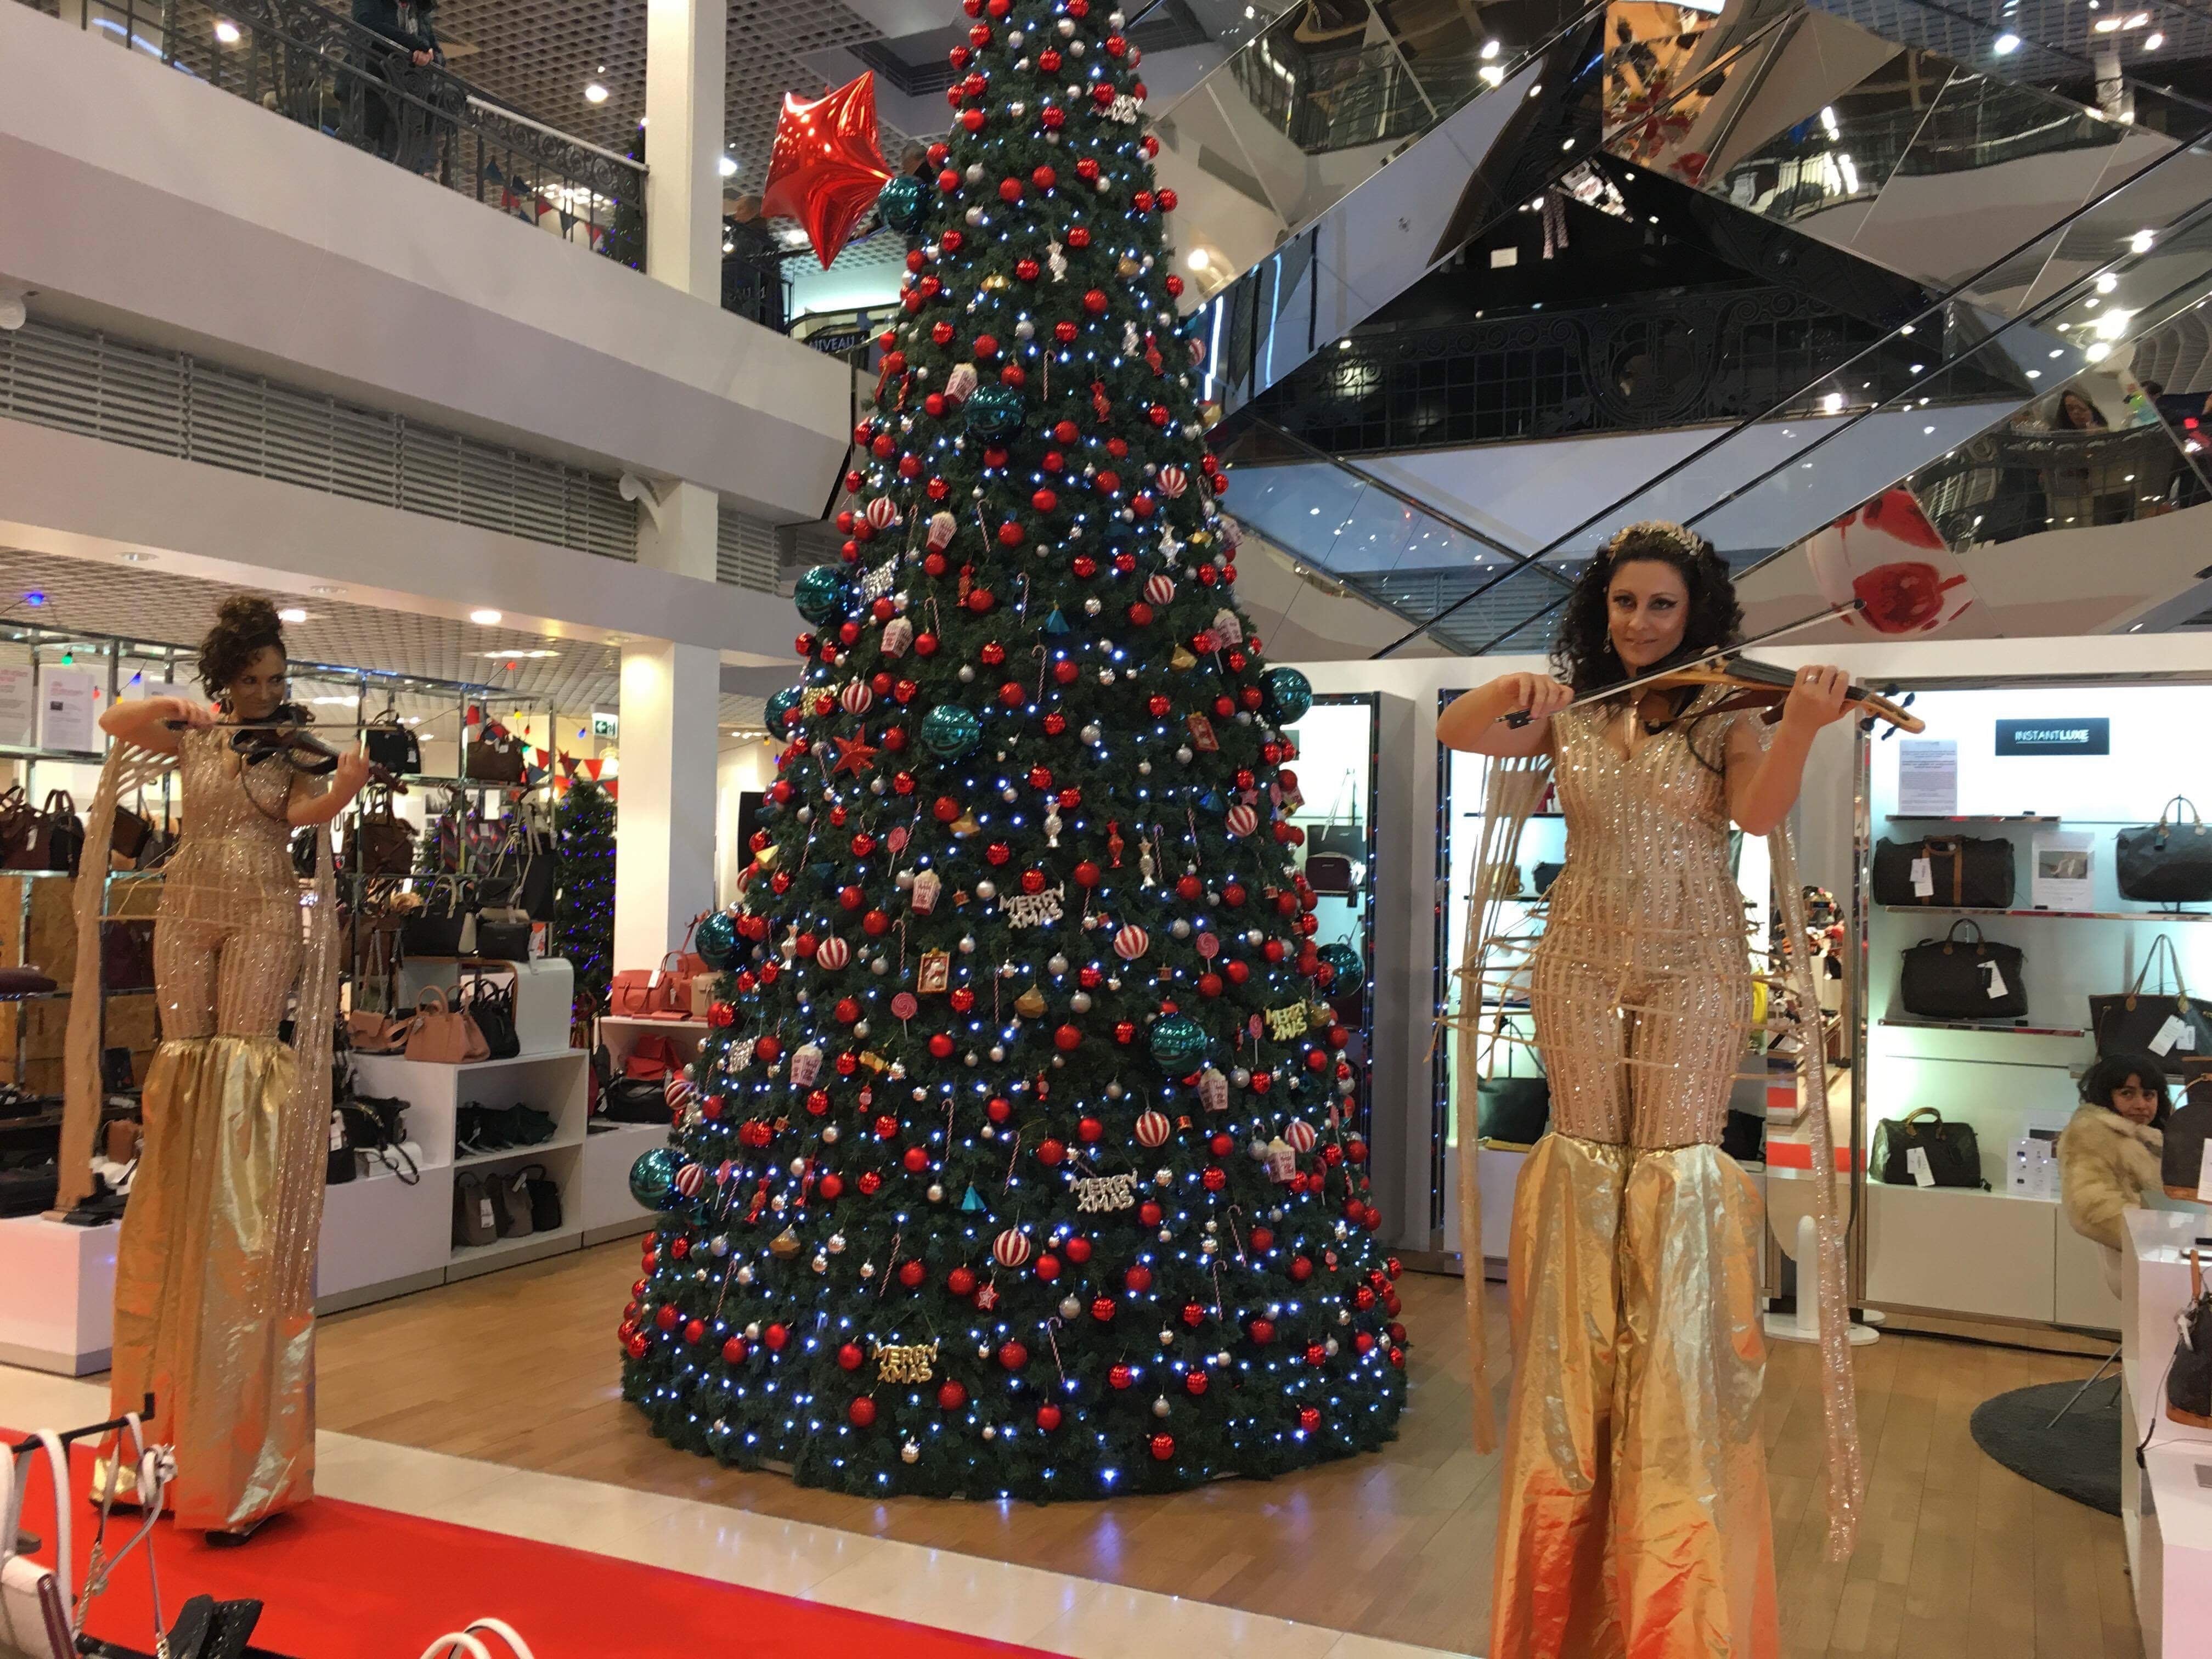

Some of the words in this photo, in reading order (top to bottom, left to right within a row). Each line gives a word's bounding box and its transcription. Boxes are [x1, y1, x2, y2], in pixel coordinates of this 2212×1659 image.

[998, 881, 1065, 912] MERRY
[1008, 902, 1064, 929] XMAS
[1069, 1169, 1138, 1195] MERRY
[1077, 1189, 1135, 1214] XMAS
[872, 1341, 939, 1365] MERRY
[877, 1361, 933, 1384] XMAS
